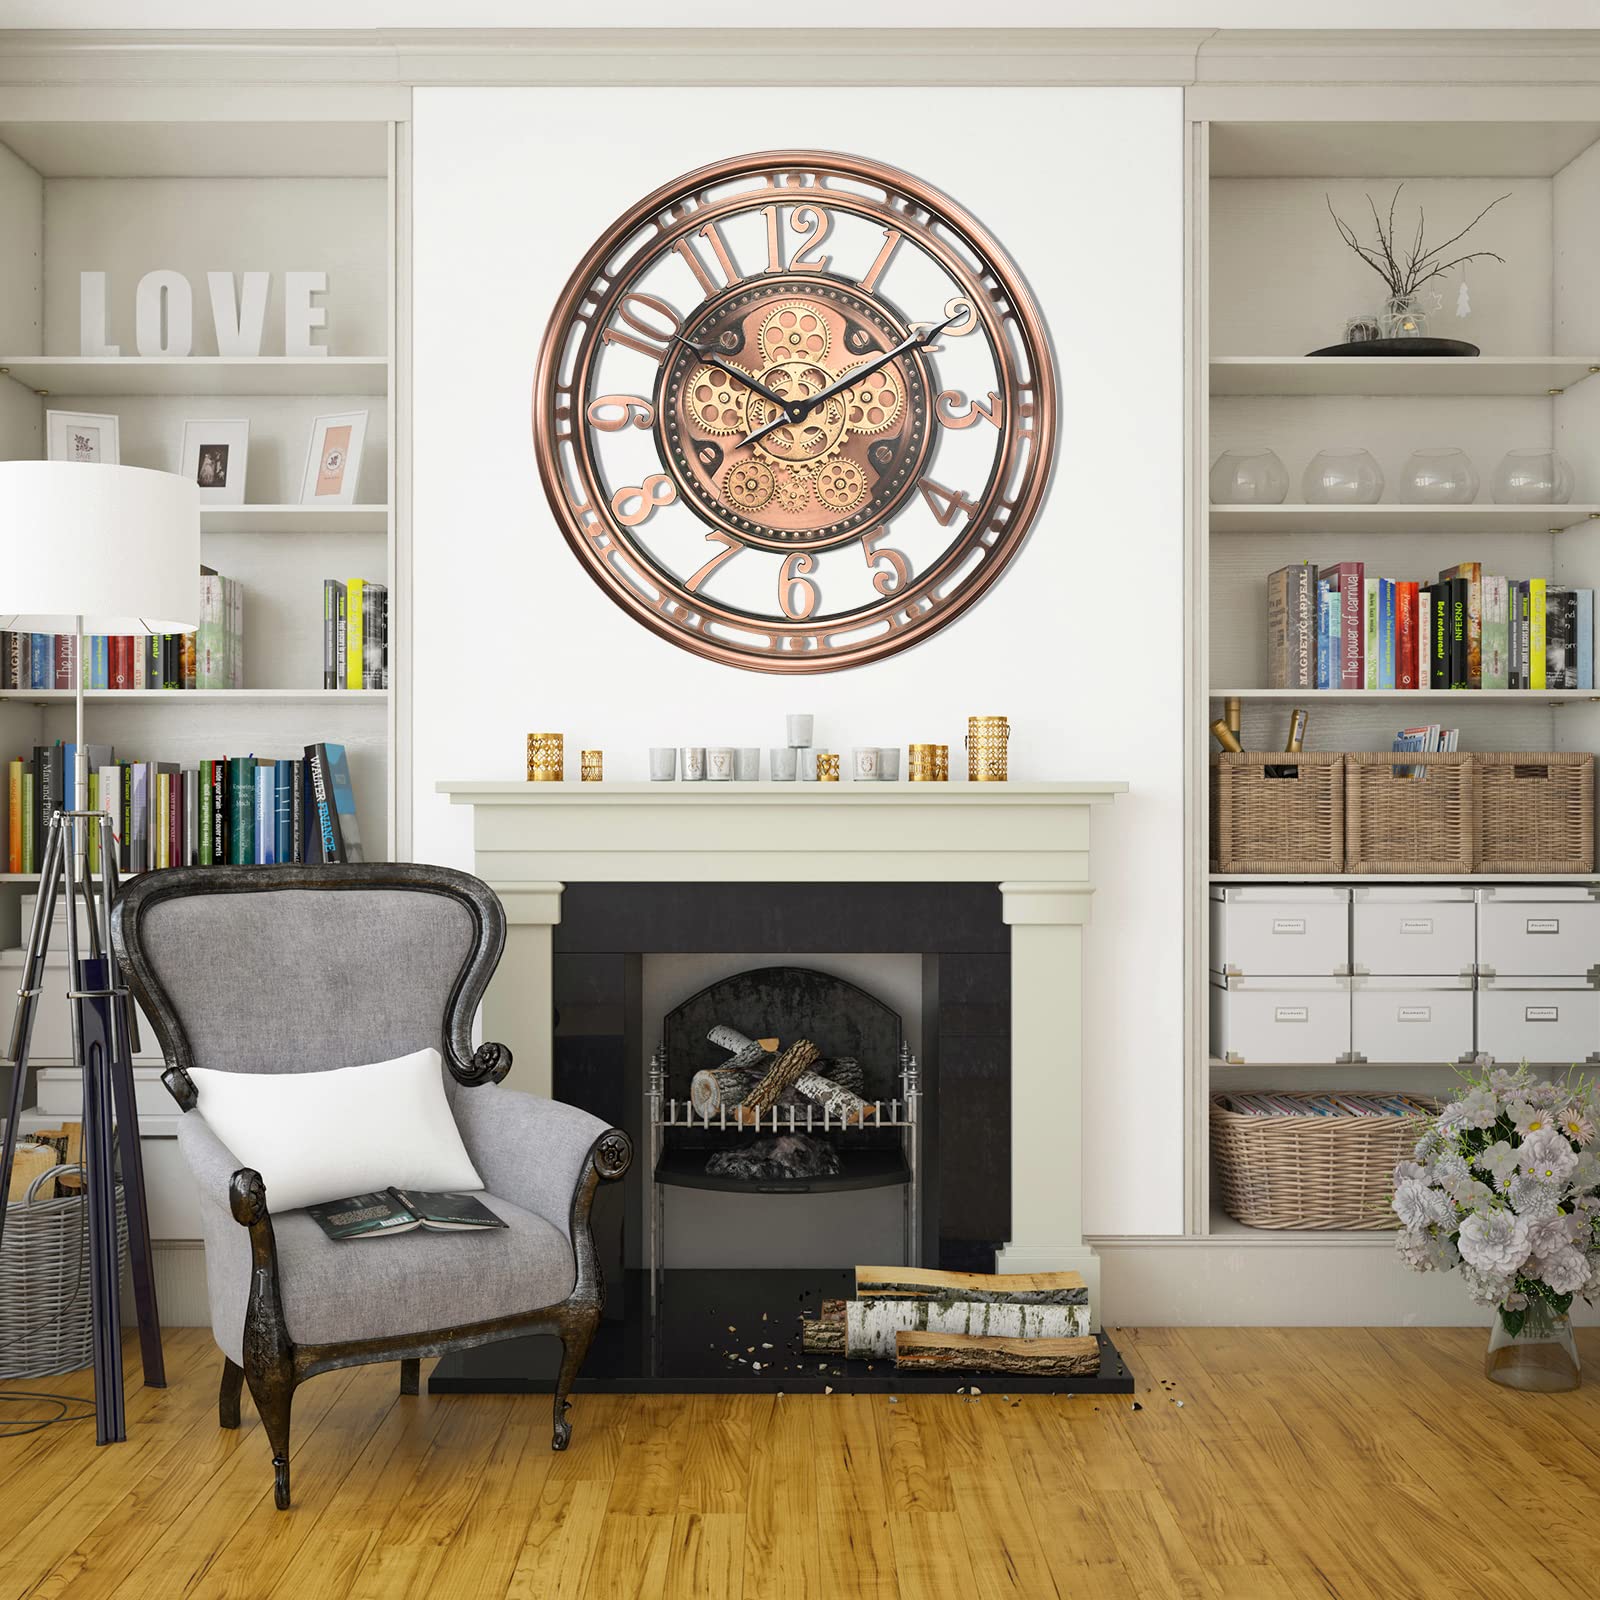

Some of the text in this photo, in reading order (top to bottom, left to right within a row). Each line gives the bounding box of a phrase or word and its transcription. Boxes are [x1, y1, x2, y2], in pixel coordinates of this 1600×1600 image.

[672, 223, 743, 300] 11
[760, 204, 830, 273] 12
[858, 230, 901, 292] 1
[80, 270, 328, 357] LOVE
[603, 293, 682, 366] 10
[907, 296, 979, 352] 2
[588, 394, 654, 432] 9
[934, 389, 1004, 430] 3
[610, 474, 677, 526] 8
[918, 476, 982, 527] 4
[684, 531, 744, 593] 7
[778, 552, 814, 620] 6
[861, 526, 909, 596] 5
[1342, 574, 1363, 680] The power of carnival
[56, 660, 72, 679] The
[43, 764, 51, 826] Man and Piano
[310, 755, 326, 802] WALTER
[318, 802, 336, 852] FINANCE
